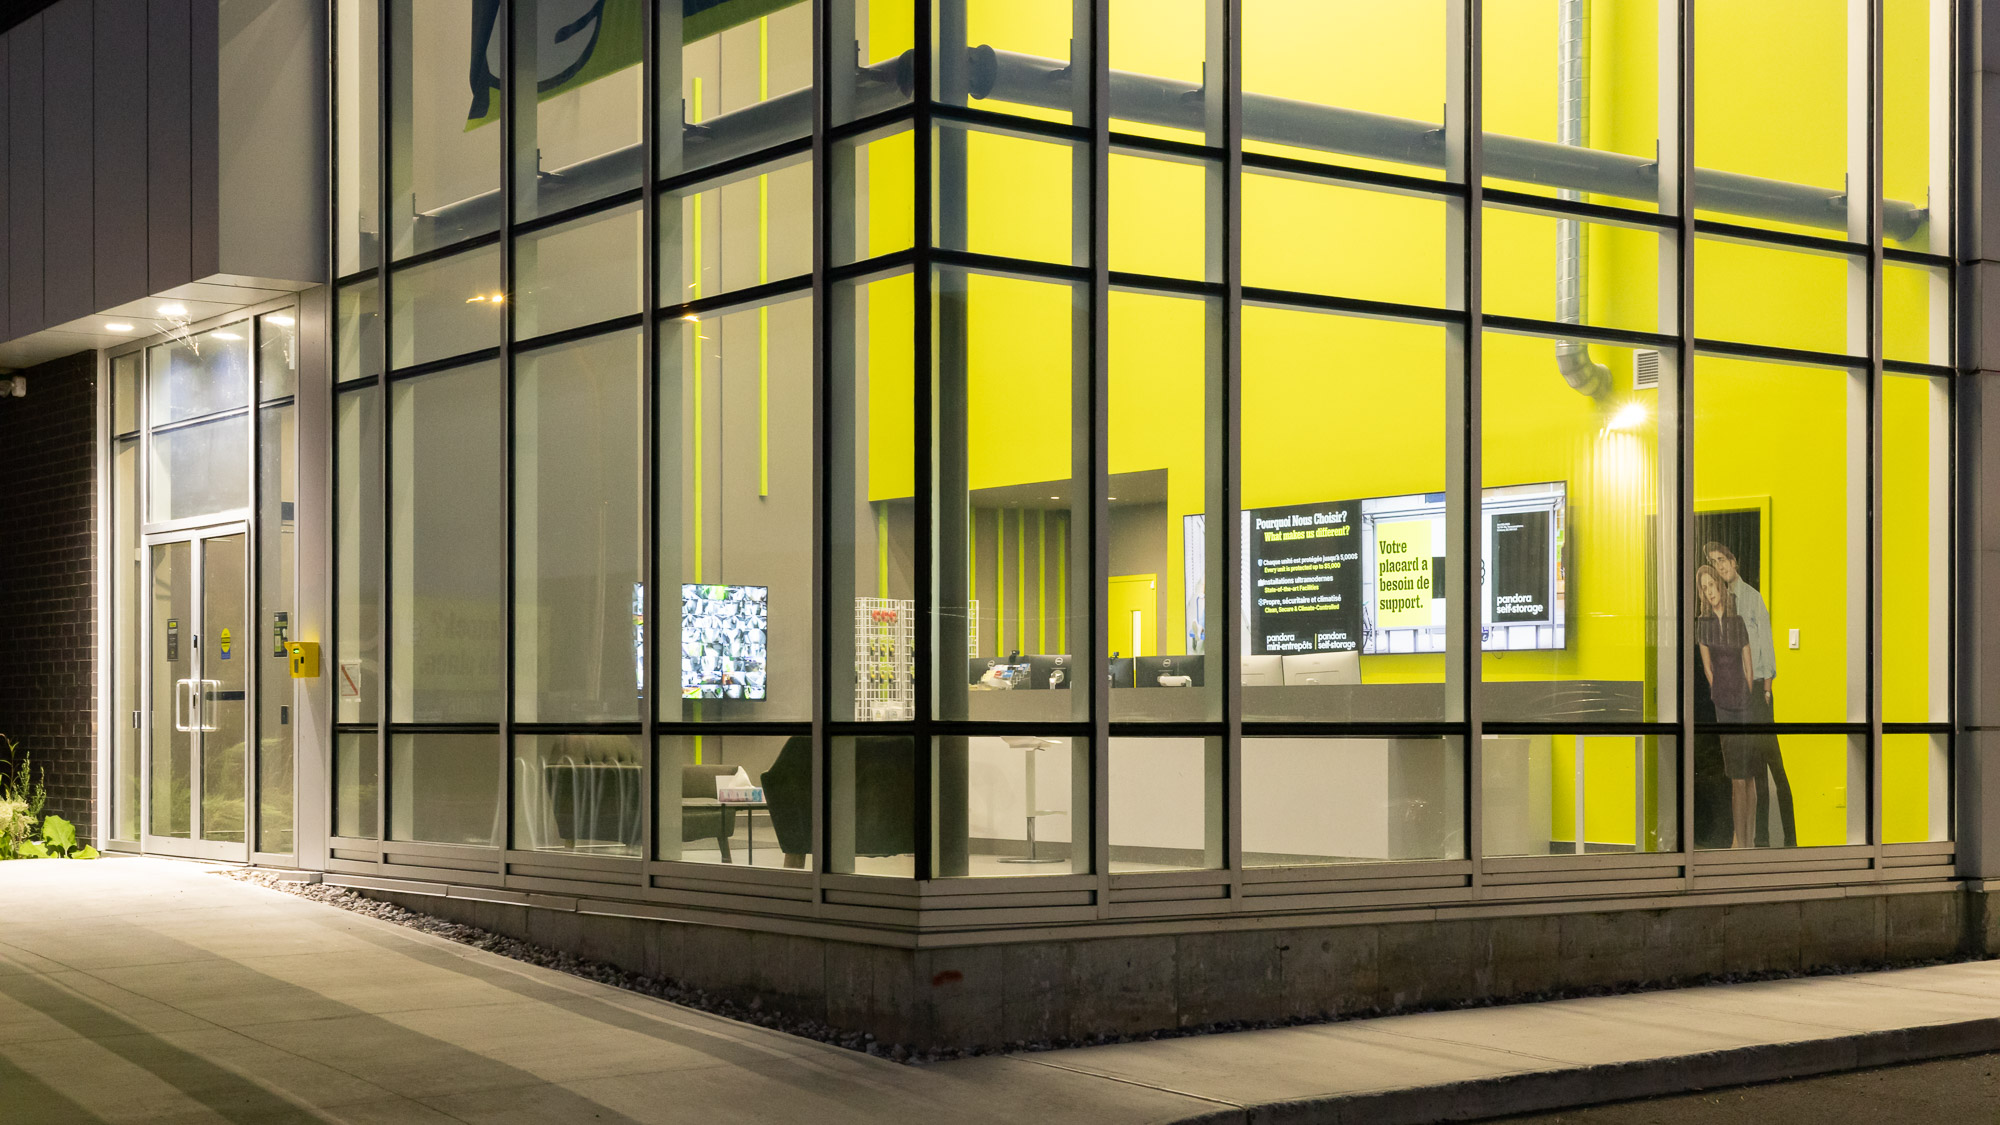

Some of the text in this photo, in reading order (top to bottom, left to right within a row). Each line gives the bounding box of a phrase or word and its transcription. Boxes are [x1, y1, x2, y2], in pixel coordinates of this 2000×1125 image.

[1256, 510, 1348, 530] Pourquoi Nous Choisir?
[1264, 525, 1350, 542] What makes us different?
[1379, 540, 1407, 554] Votre
[1340, 553, 1358, 562] 5,000$
[1291, 564, 1312, 572] protected
[1324, 562, 1341, 570] $5,000
[1380, 556, 1428, 576] placard a
[1380, 575, 1430, 592] besoin de
[1380, 594, 1424, 613] support.
[1496, 592, 1532, 606] pandora
[1496, 603, 1544, 615] self-storage
[1266, 632, 1295, 644] pandora
[1318, 631, 1347, 642] pandora
[1266, 640, 1313, 652] mini-entrepôts
[1318, 640, 1356, 650] self-storage
